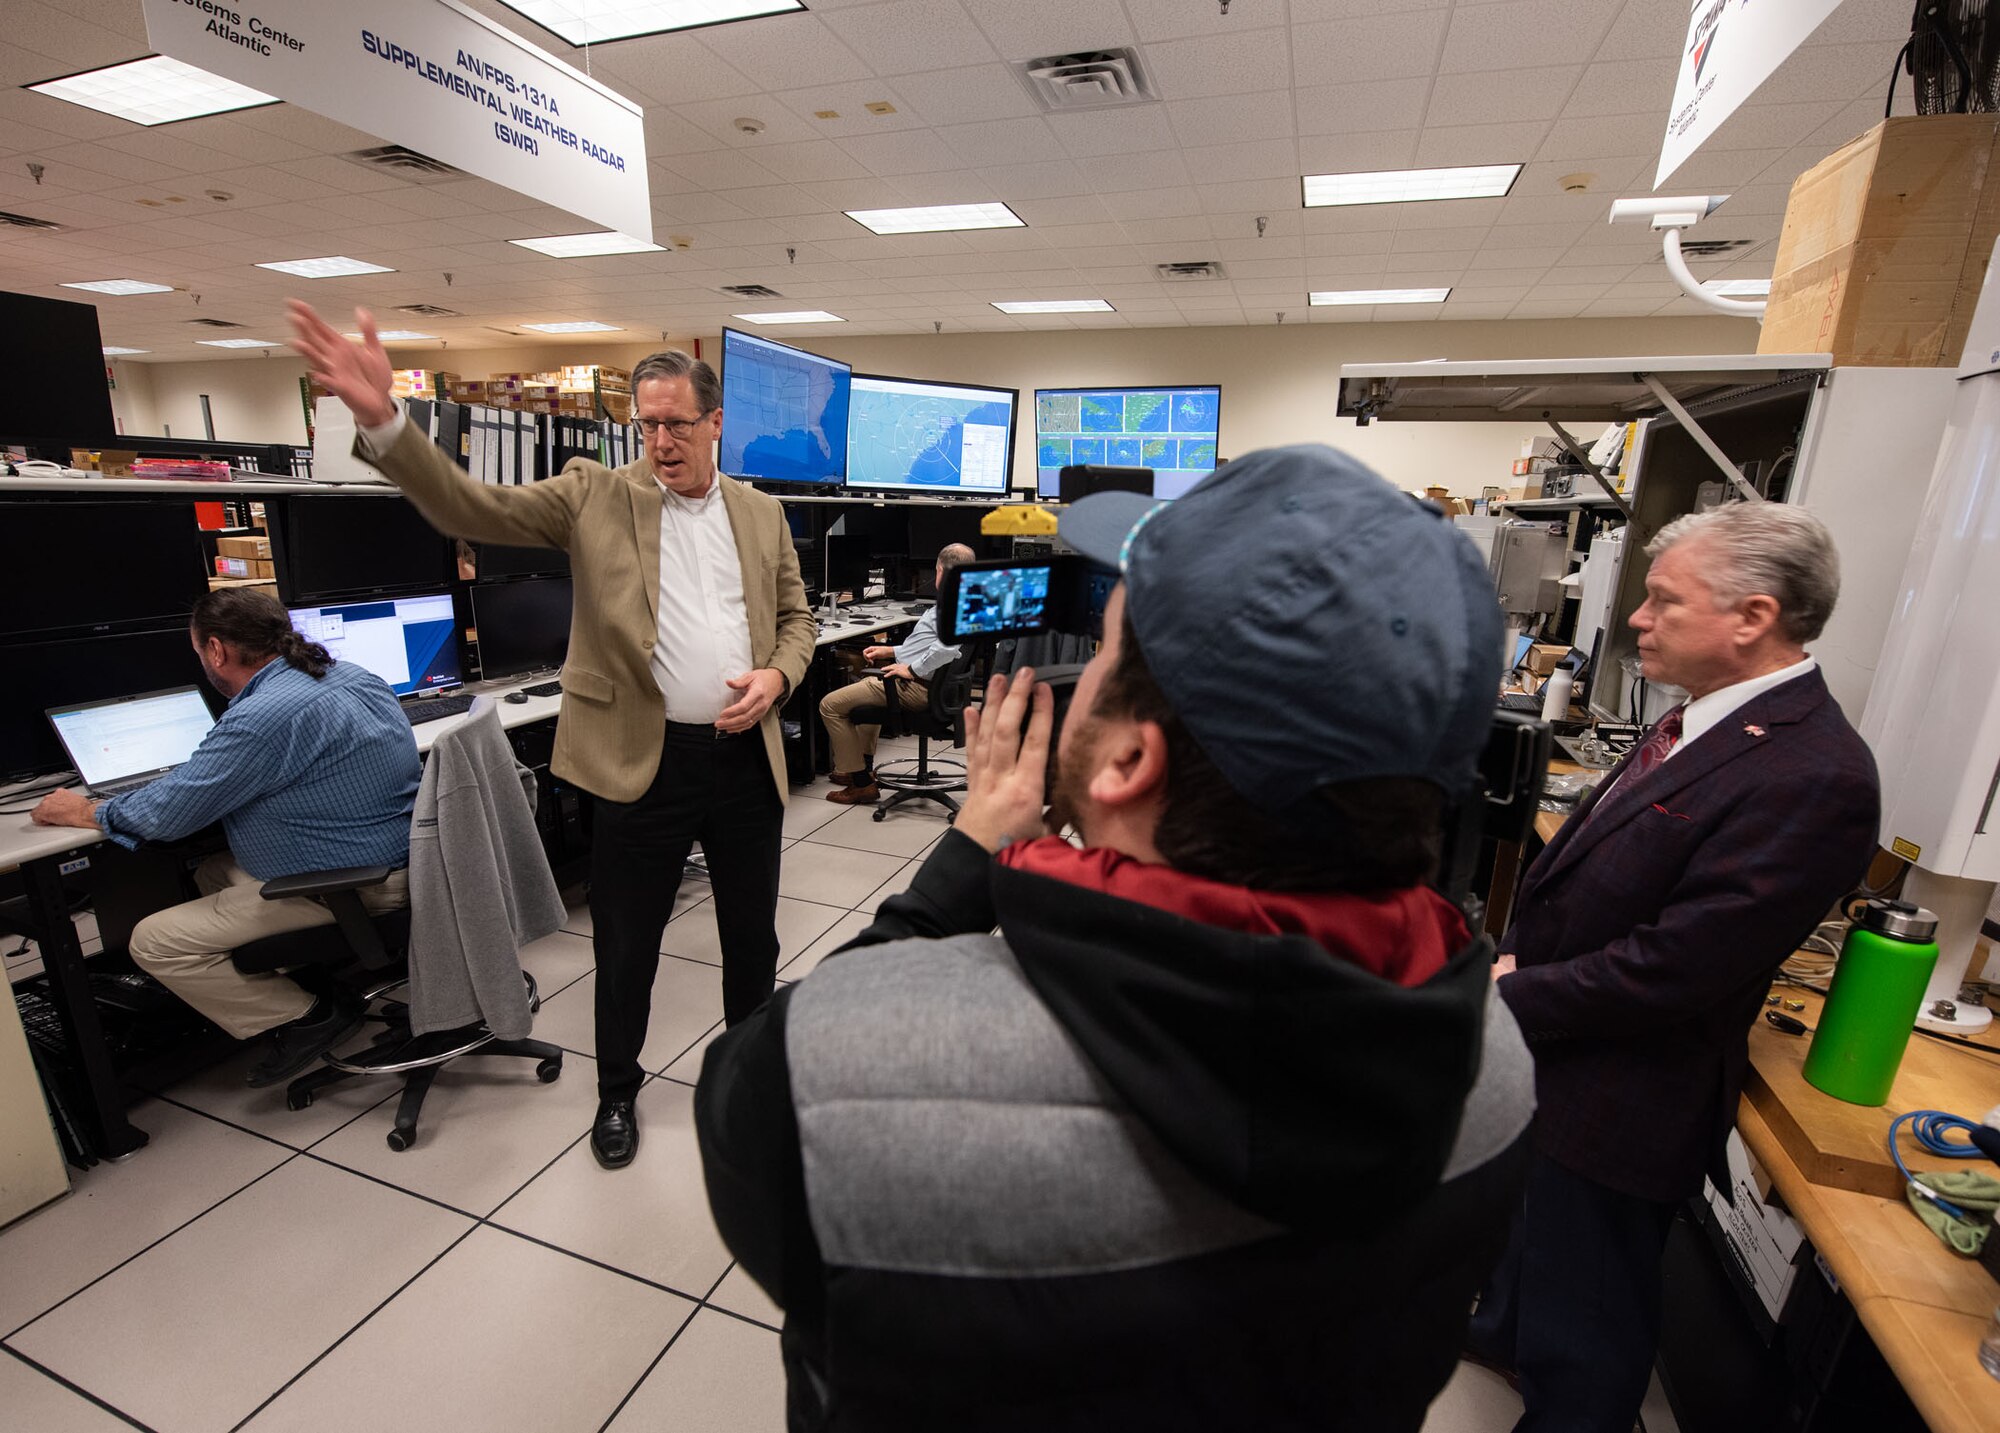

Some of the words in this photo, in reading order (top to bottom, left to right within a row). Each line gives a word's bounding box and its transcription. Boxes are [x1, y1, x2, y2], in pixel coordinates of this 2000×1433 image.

[205, 19, 271, 57] Atlantic
[249, 17, 305, 52] Center
[361, 29, 507, 117] SUPPLEMENTAL
[509, 102, 578, 150] WEATHER
[581, 138, 625, 174] RADAR
[456, 49, 560, 117] AN/FPS-131A
[494, 121, 539, 157] (SWR)
